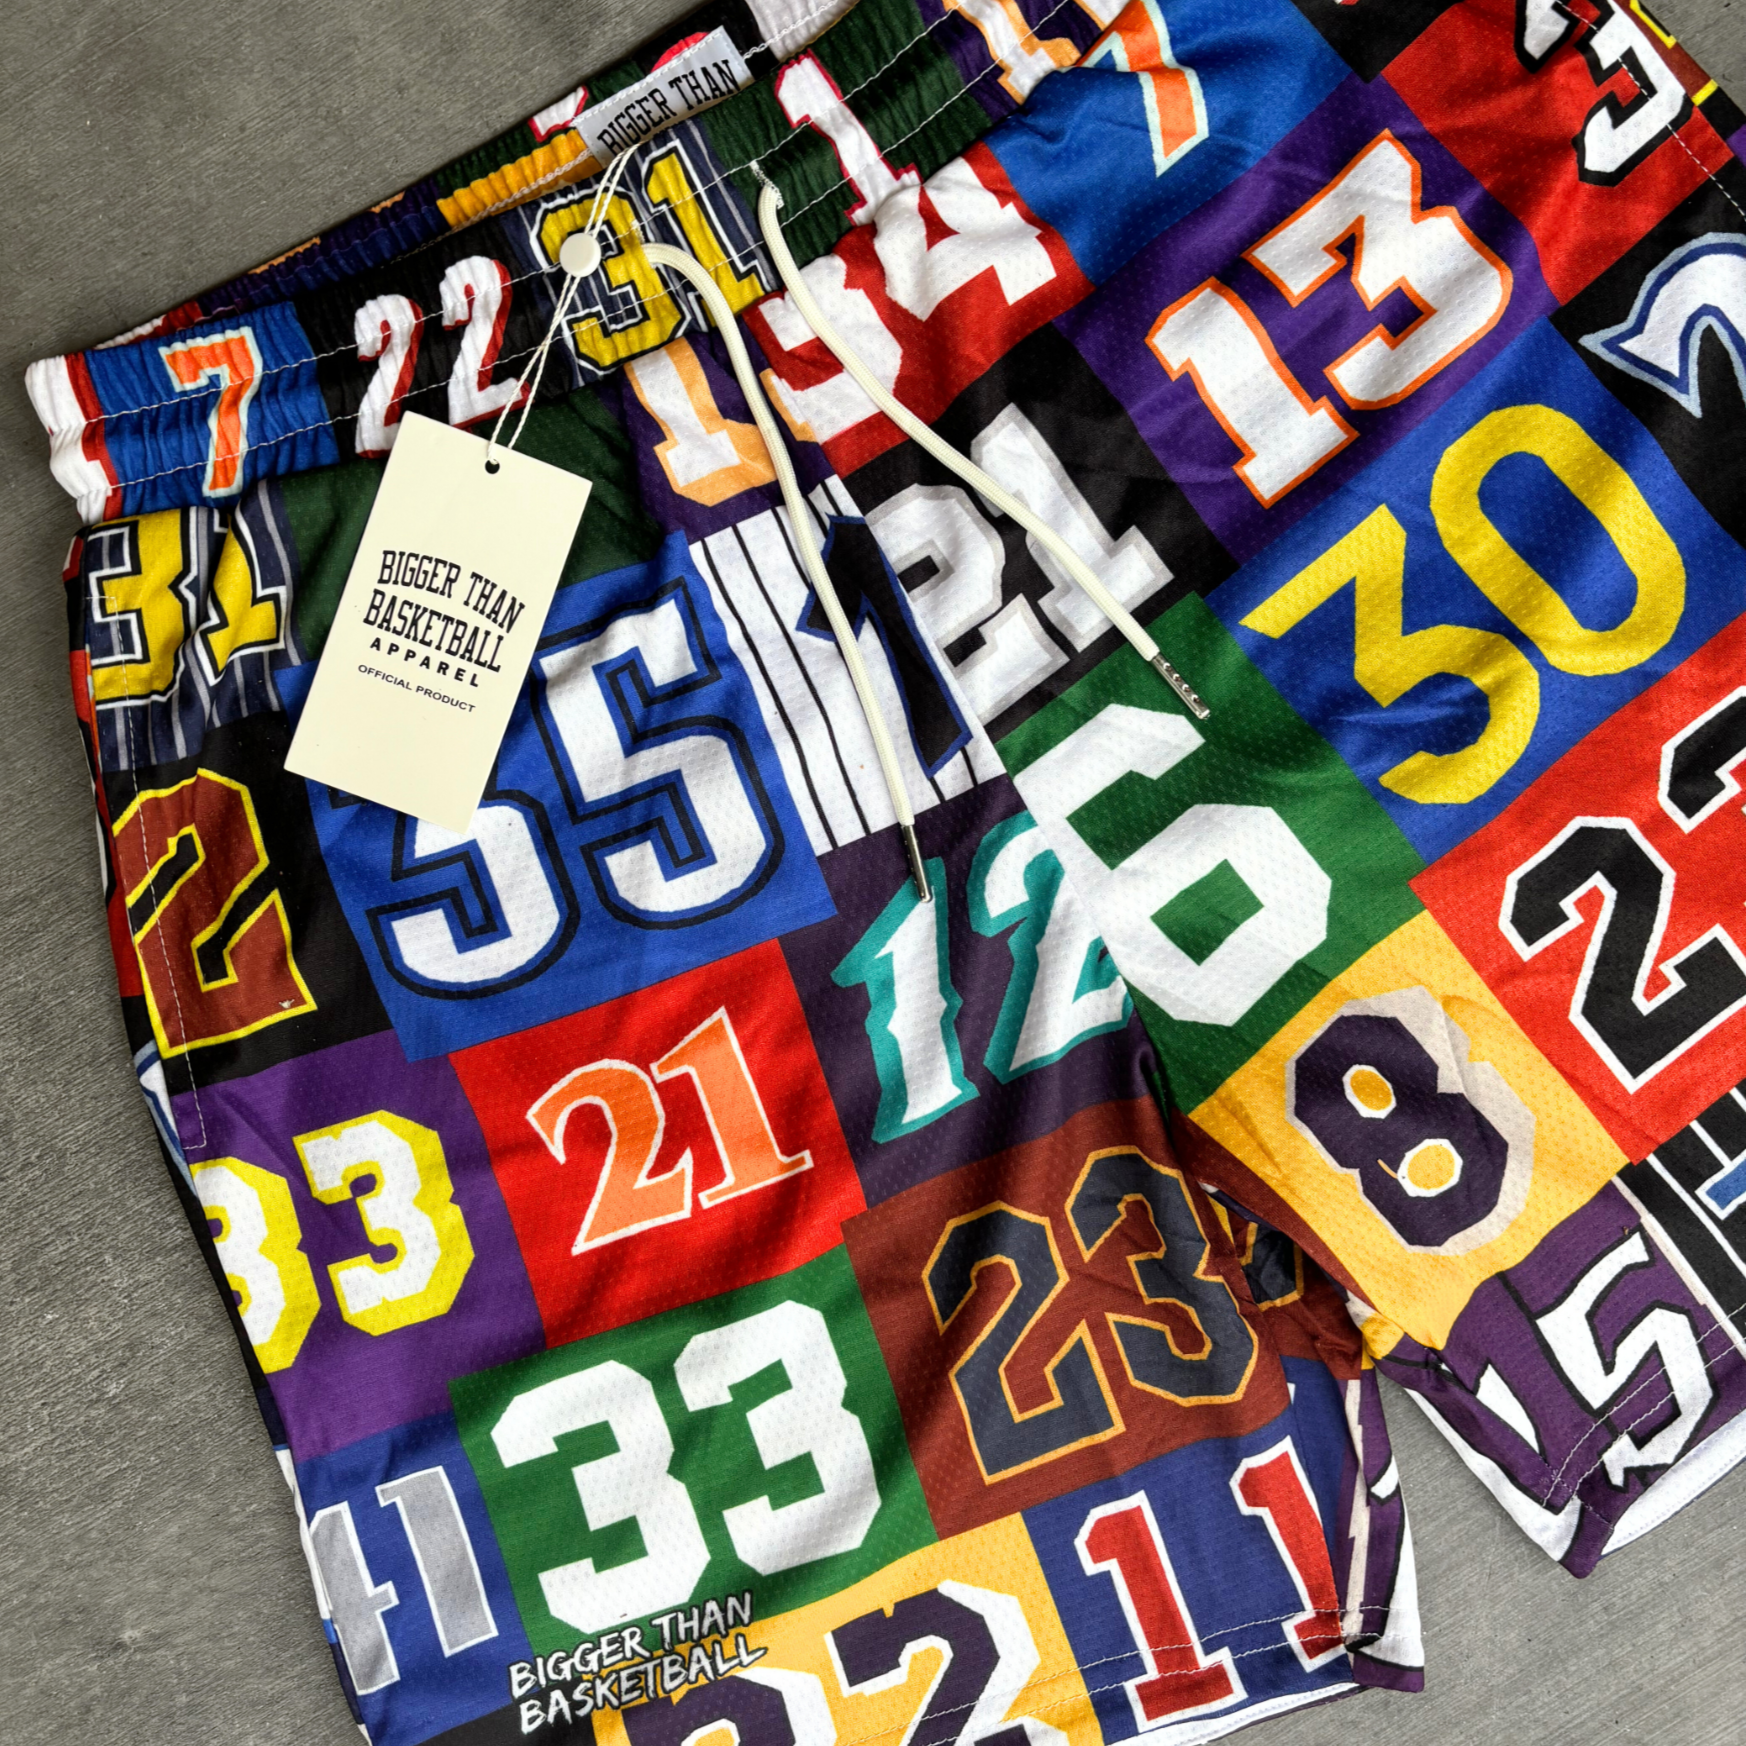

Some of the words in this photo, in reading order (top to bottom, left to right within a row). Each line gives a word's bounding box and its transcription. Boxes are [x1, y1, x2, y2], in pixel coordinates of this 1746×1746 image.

[668, 59, 741, 111] THAN
[354, 255, 534, 458] 22
[530, 139, 772, 374] 31
[1145, 128, 1513, 509] 13
[158, 326, 263, 498] 7
[357, 664, 413, 691] OFFICIAL
[415, 685, 477, 713] PRODUCT
[363, 588, 504, 673] BASKETBALL
[369, 637, 480, 688] APPAREL
[377, 549, 462, 599] BIGGER
[463, 571, 526, 634] THAN
[864, 403, 1174, 727] 21
[1239, 403, 1686, 804] 30
[111, 767, 318, 1060] 2
[831, 810, 1134, 1143] 12
[1012, 702, 1335, 1027] 6
[526, 1005, 814, 1255] 21
[1285, 985, 1536, 1256] 8
[921, 1145, 1260, 1485] 23
[490, 1299, 882, 1635] 33
[1074, 1435, 1352, 1733] 11
[507, 1625, 652, 1699] BIGGER
[649, 1590, 752, 1652] THAN
[518, 1633, 769, 1735] BASKETBALL
